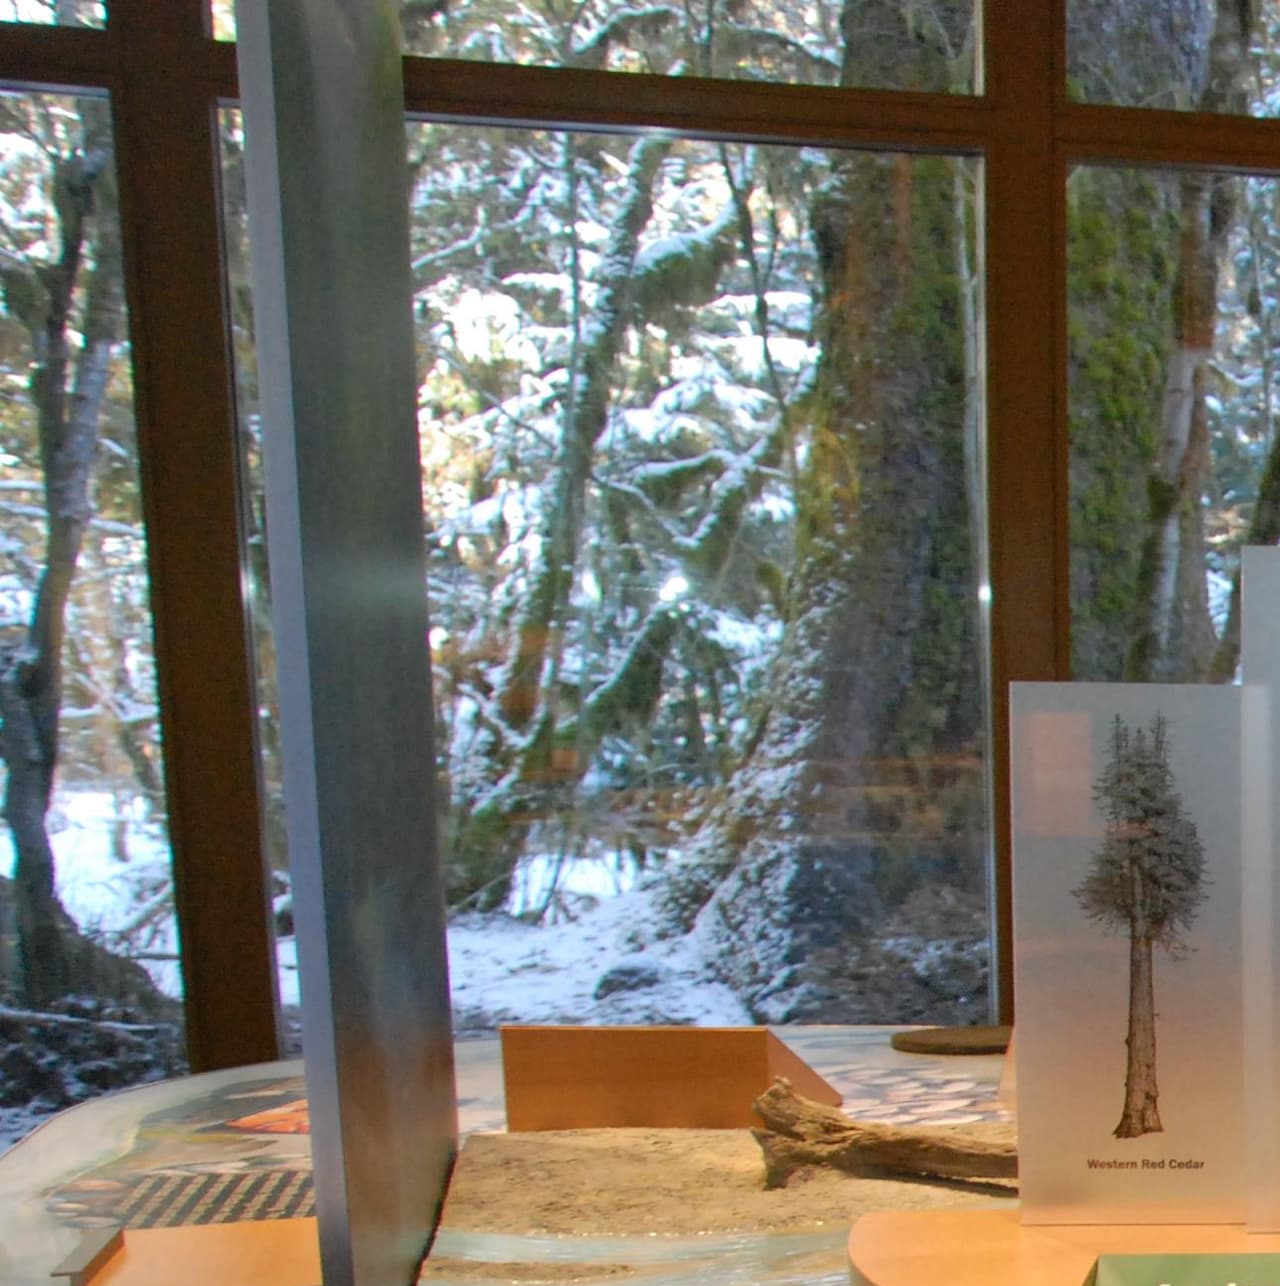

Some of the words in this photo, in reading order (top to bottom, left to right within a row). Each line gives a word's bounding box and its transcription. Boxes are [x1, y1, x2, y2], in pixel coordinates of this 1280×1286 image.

[1087, 1159, 1137, 1169] Western
[1141, 1159, 1165, 1169] Red
[1168, 1158, 1205, 1169] Cedar
